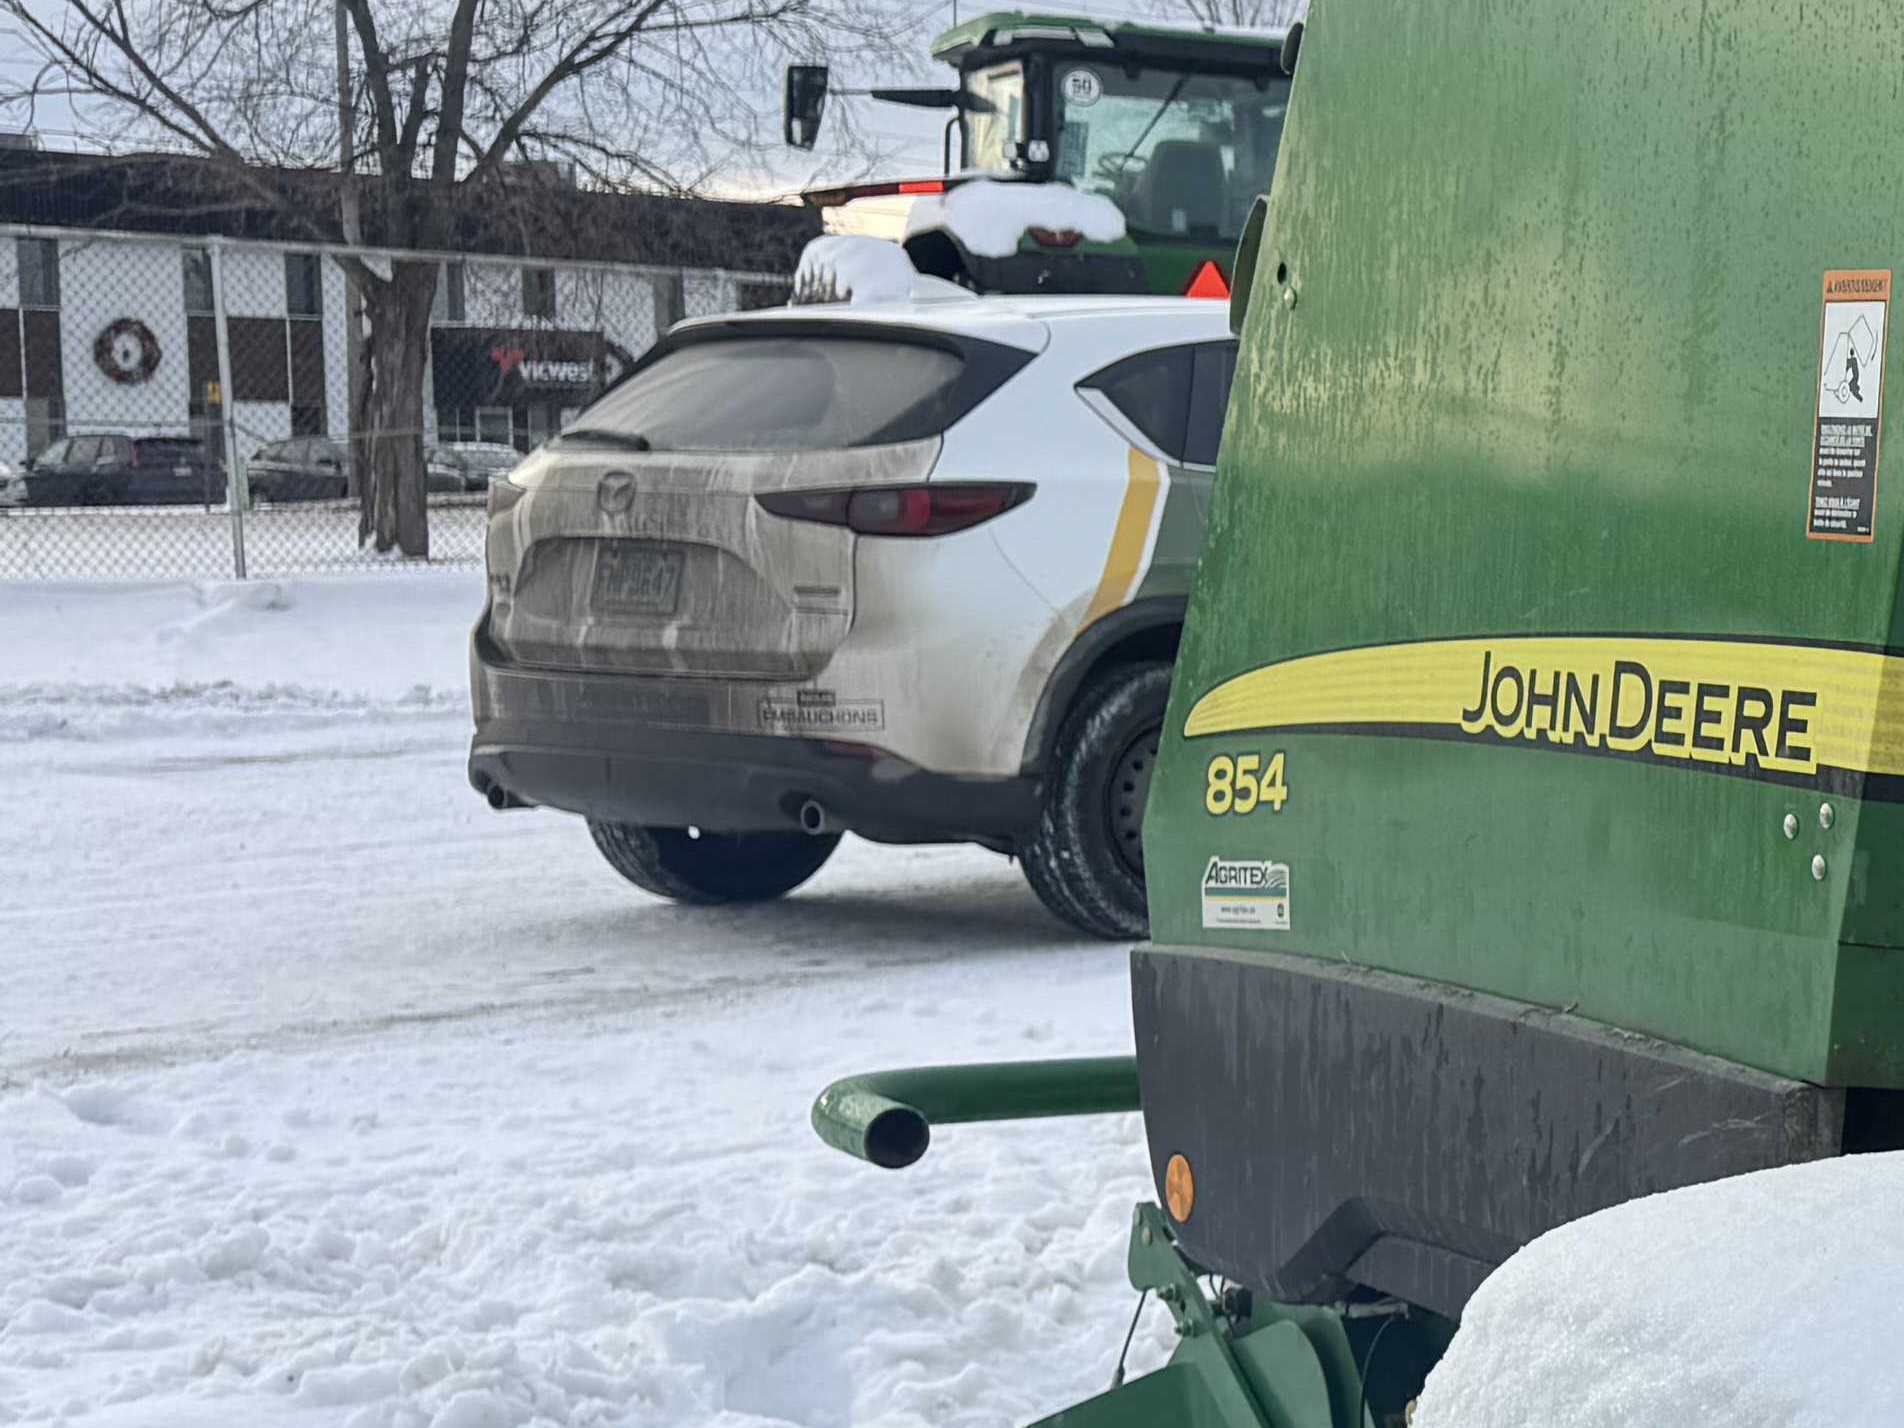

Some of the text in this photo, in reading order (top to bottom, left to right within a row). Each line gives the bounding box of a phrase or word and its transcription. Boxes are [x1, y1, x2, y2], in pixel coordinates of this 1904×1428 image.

[1462, 651, 1818, 762] JOHN DEERE
[1206, 753, 1287, 815] 854
[1205, 861, 1269, 885] AGRITEX
